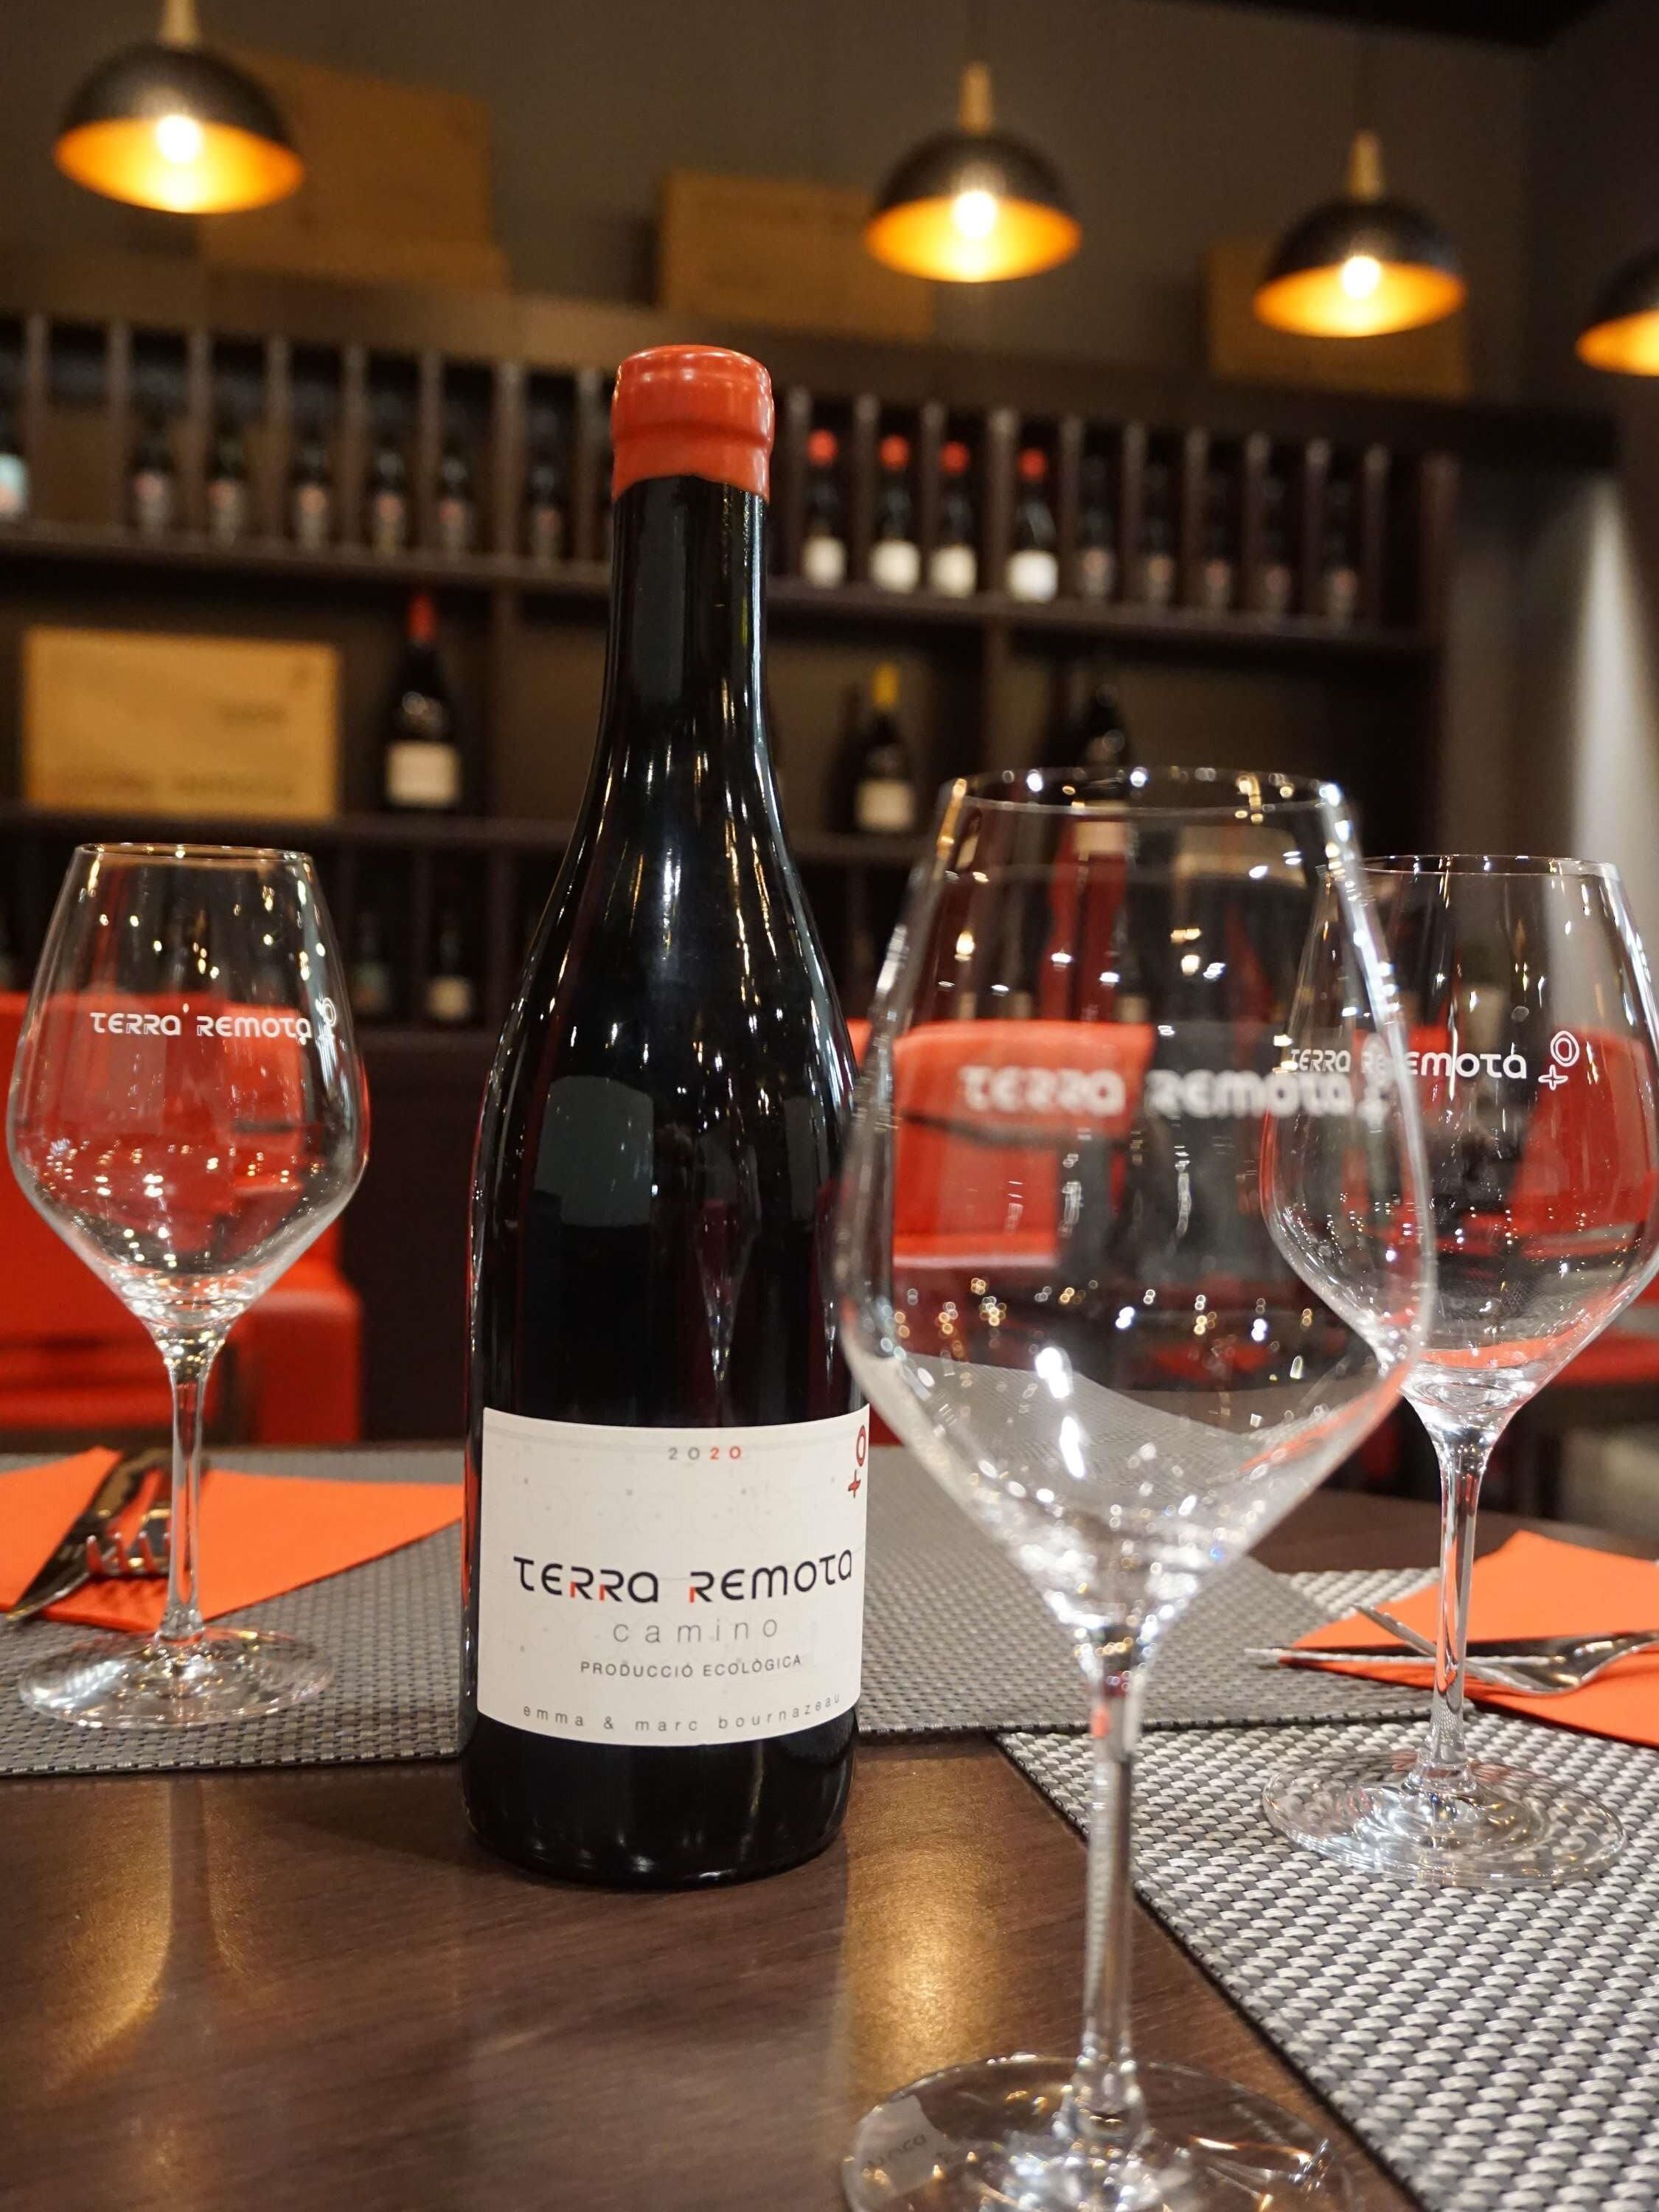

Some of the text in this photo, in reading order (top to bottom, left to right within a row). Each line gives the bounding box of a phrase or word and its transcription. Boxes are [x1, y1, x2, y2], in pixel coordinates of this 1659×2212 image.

[668, 1445, 742, 1461] 2020
[613, 1618, 778, 1644] camino
[580, 1660, 693, 1678] PRODUCCIÓ
[523, 1693, 840, 1732] emma & marc bournazeau
